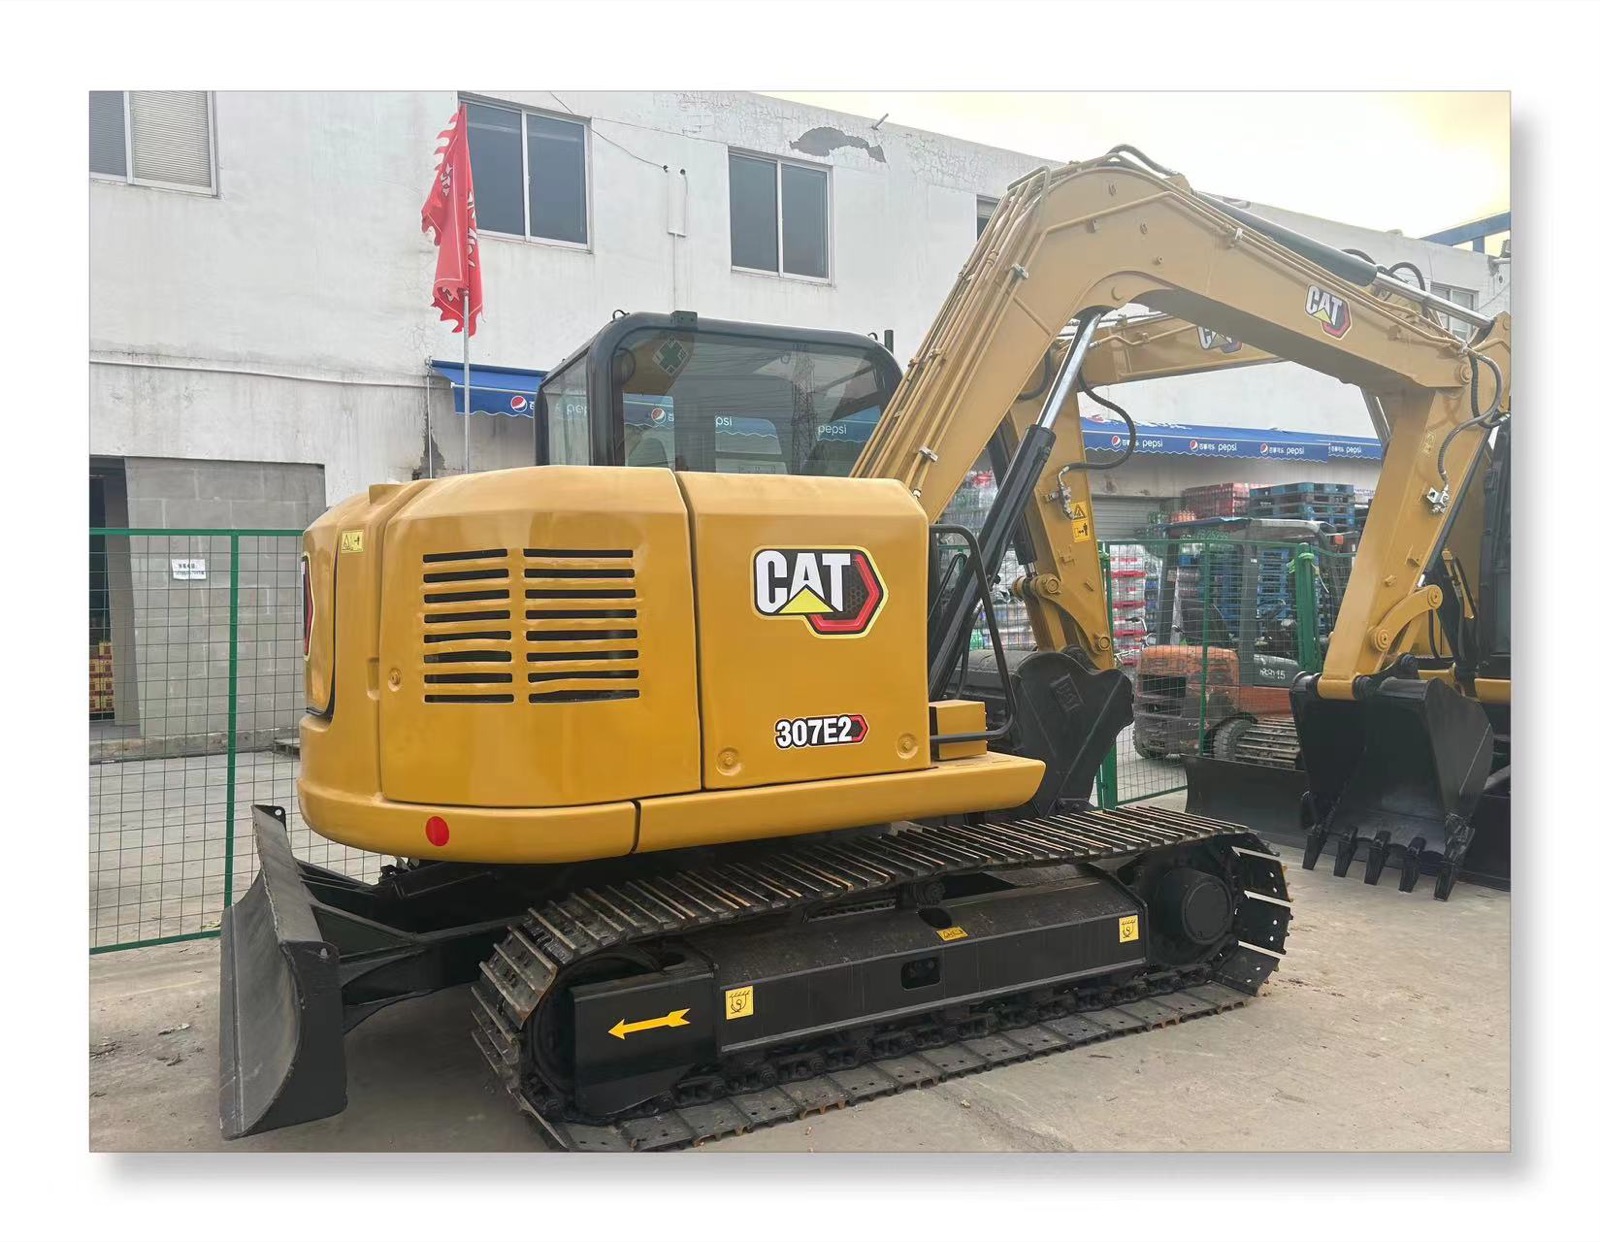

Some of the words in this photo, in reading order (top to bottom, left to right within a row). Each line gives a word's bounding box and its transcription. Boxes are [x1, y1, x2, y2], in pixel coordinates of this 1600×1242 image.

[1307, 285, 1343, 326] CAT
[817, 424, 847, 436] pepsi
[1142, 438, 1163, 448] pepsi
[1218, 442, 1237, 453] pepsi
[1286, 446, 1305, 456] pepsi
[755, 550, 851, 613] CAT
[776, 716, 853, 747] 307E2
